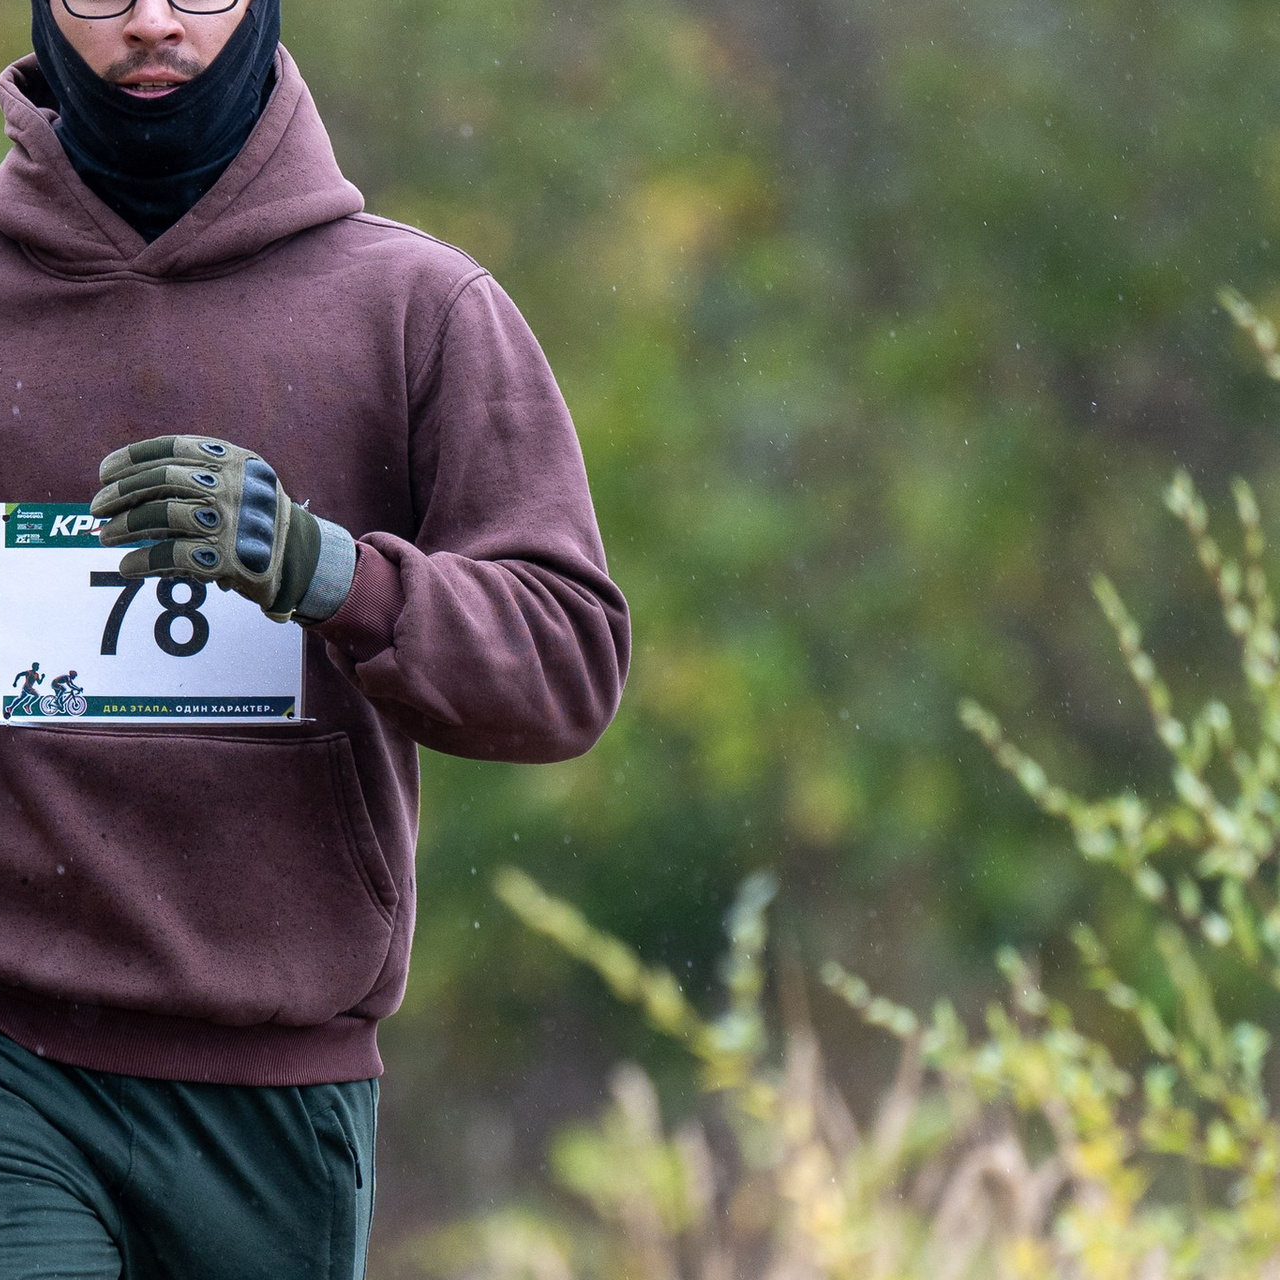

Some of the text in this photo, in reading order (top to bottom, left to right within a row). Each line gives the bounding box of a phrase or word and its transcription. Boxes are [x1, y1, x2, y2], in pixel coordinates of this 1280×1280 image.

[90, 571, 210, 657] 78
[103, 705, 275, 714] ДВА ЭТАПА. ОДИН ХАРАКТЕР.
